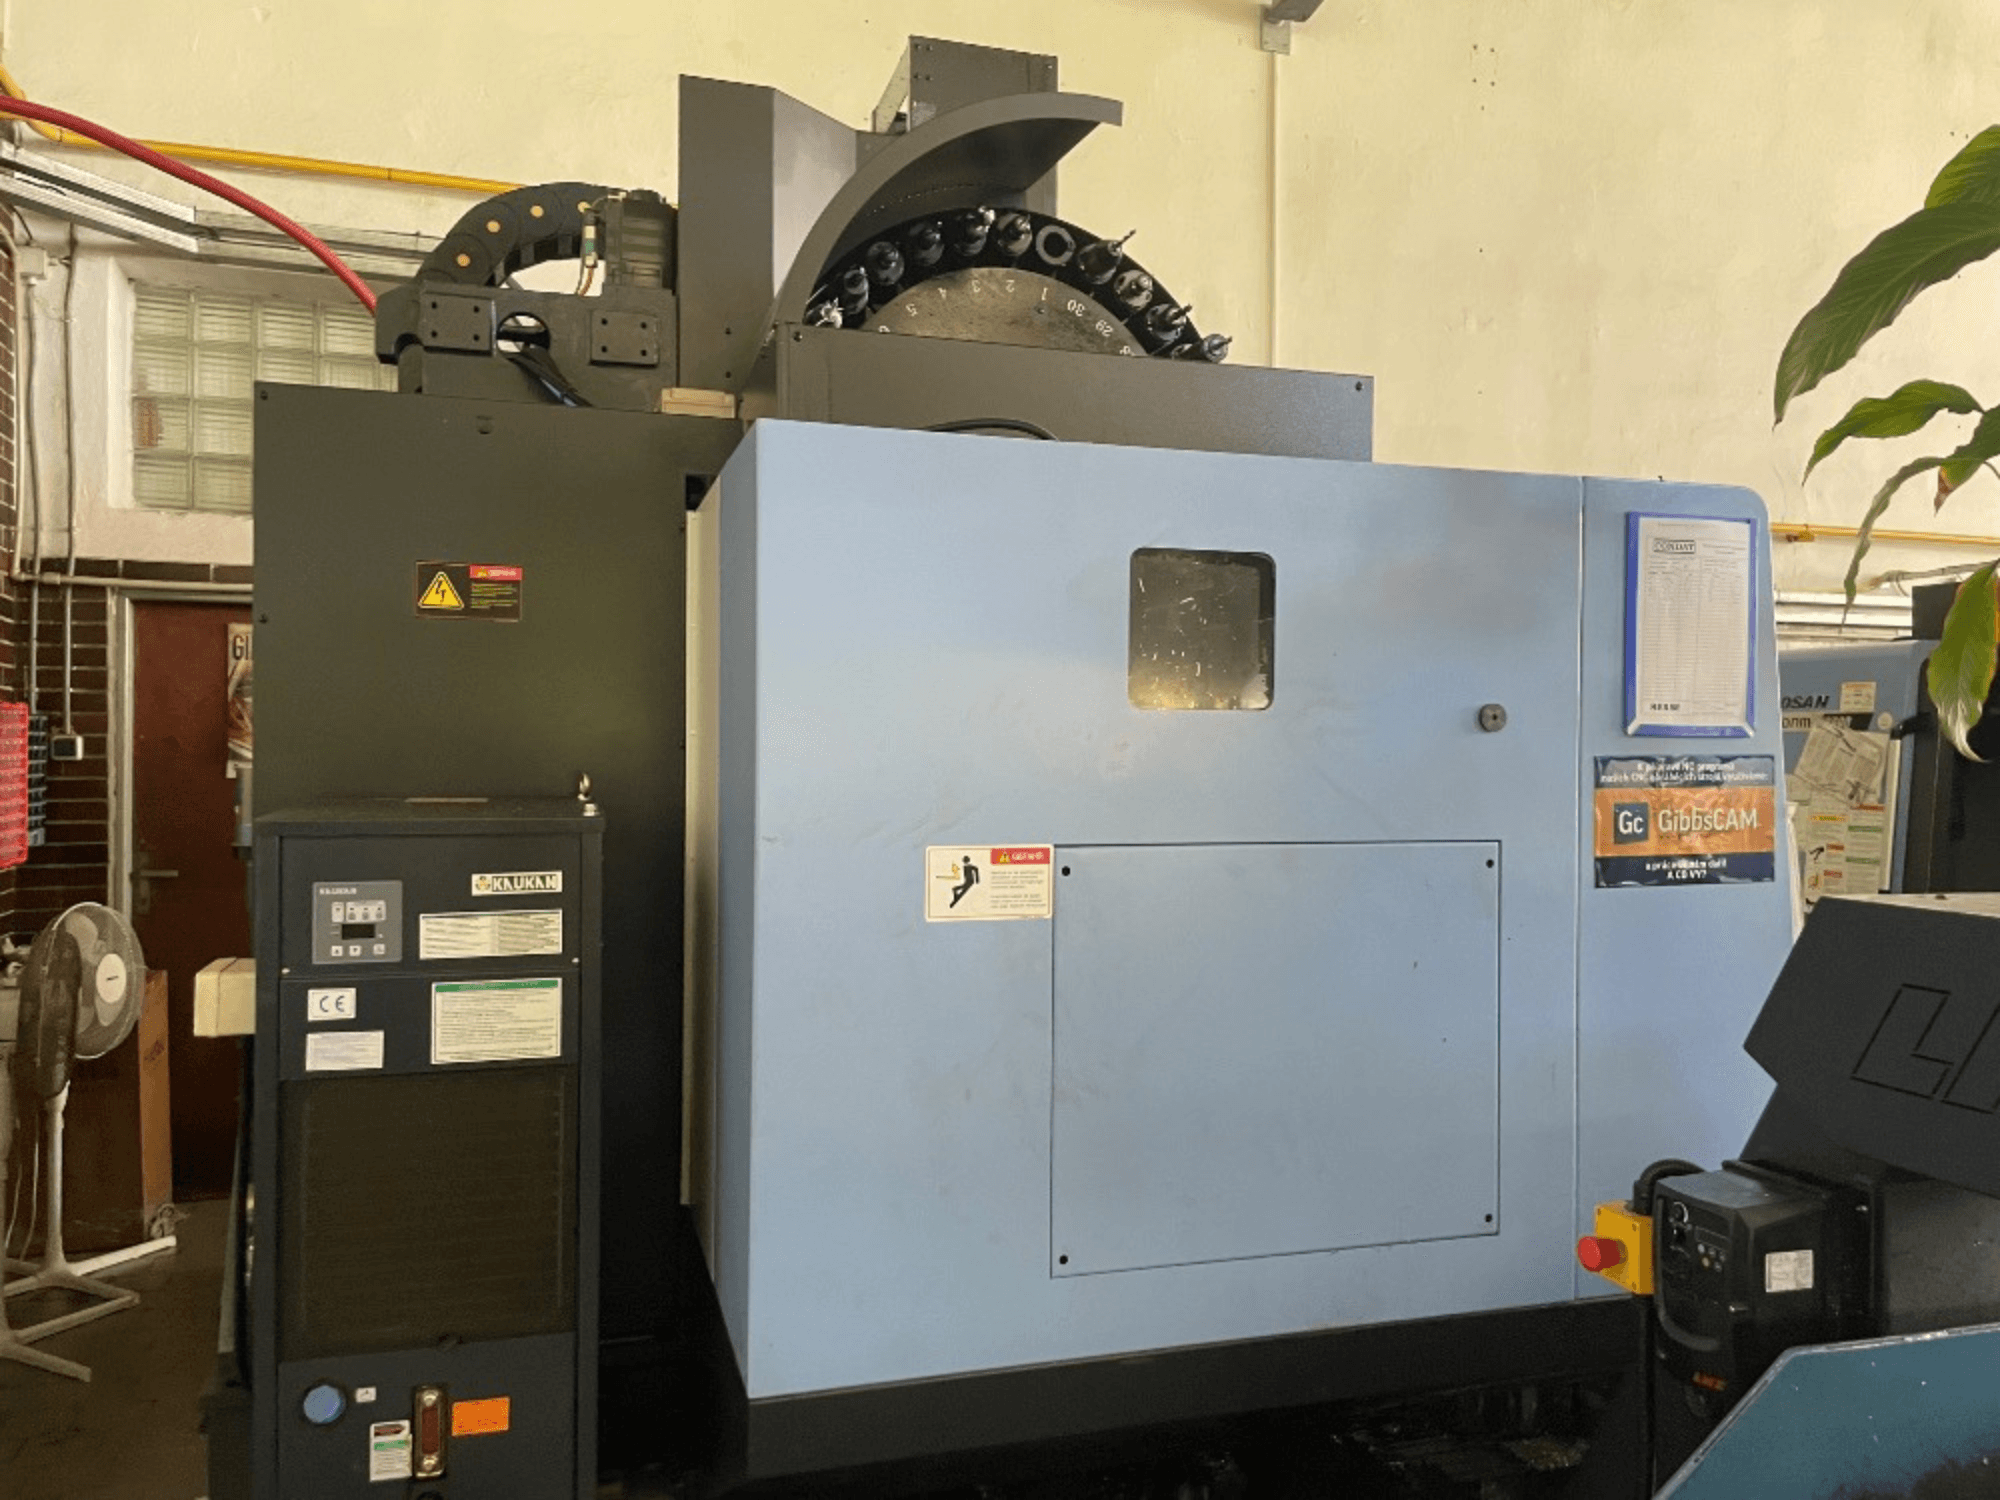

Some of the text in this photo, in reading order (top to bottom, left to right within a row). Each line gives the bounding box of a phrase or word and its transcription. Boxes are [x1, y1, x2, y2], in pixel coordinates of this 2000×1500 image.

[1005, 279, 1015, 293] 2
[1041, 287, 1048, 301] 1
[1067, 299, 1085, 317] 30
[1095, 319, 1114, 337] 29
[1618, 807, 1758, 834] Gc GibbsCAM
[493, 875, 557, 891] KAUKAN
[319, 995, 345, 1013] CE
